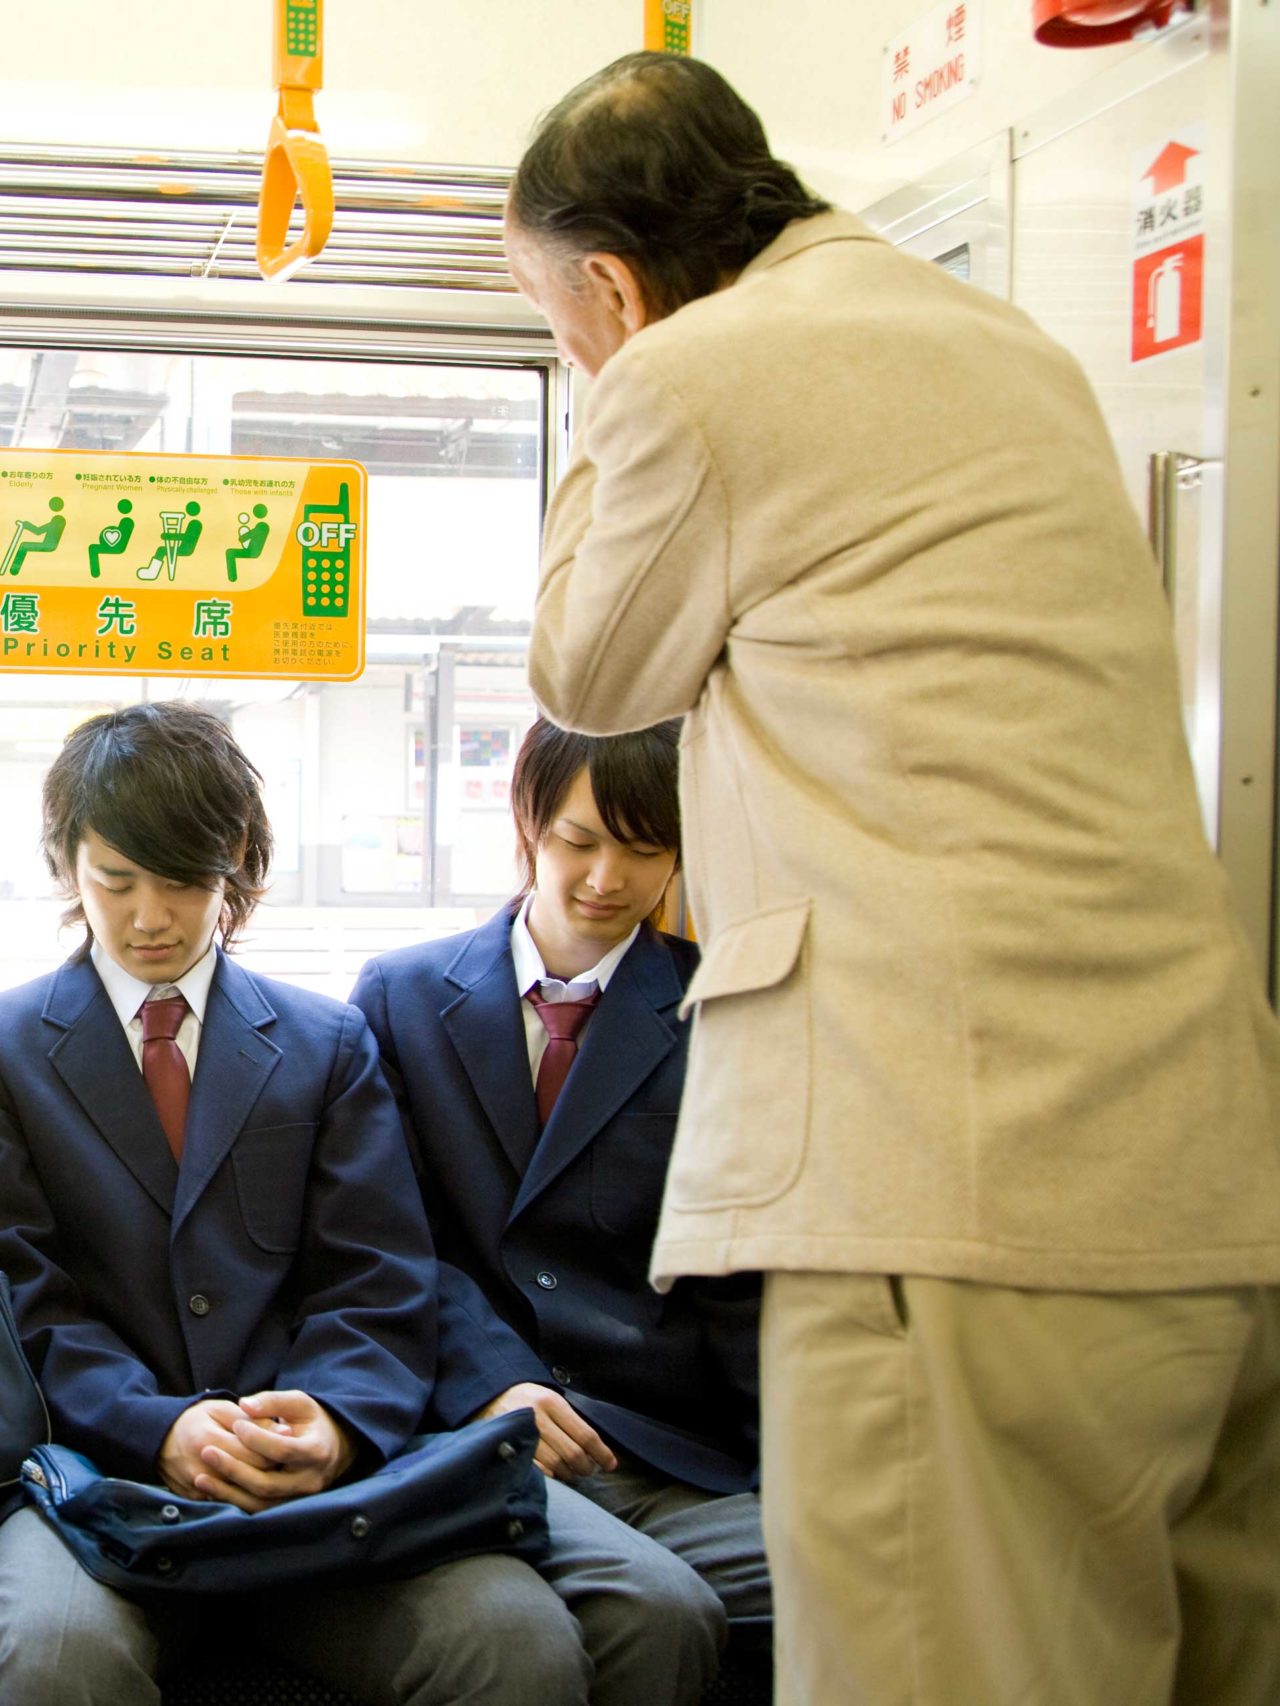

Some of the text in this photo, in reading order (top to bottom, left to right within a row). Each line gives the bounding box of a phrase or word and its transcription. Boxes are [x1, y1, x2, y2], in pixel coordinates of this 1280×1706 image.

[892, 54, 964, 125] NO SMOKING
[9, 480, 34, 488] Elderly
[82, 483, 114, 491] Pregnant
[296, 521, 357, 548] OFF
[0, 593, 232, 637] 優先席
[3, 638, 230, 662] Priority Seat
